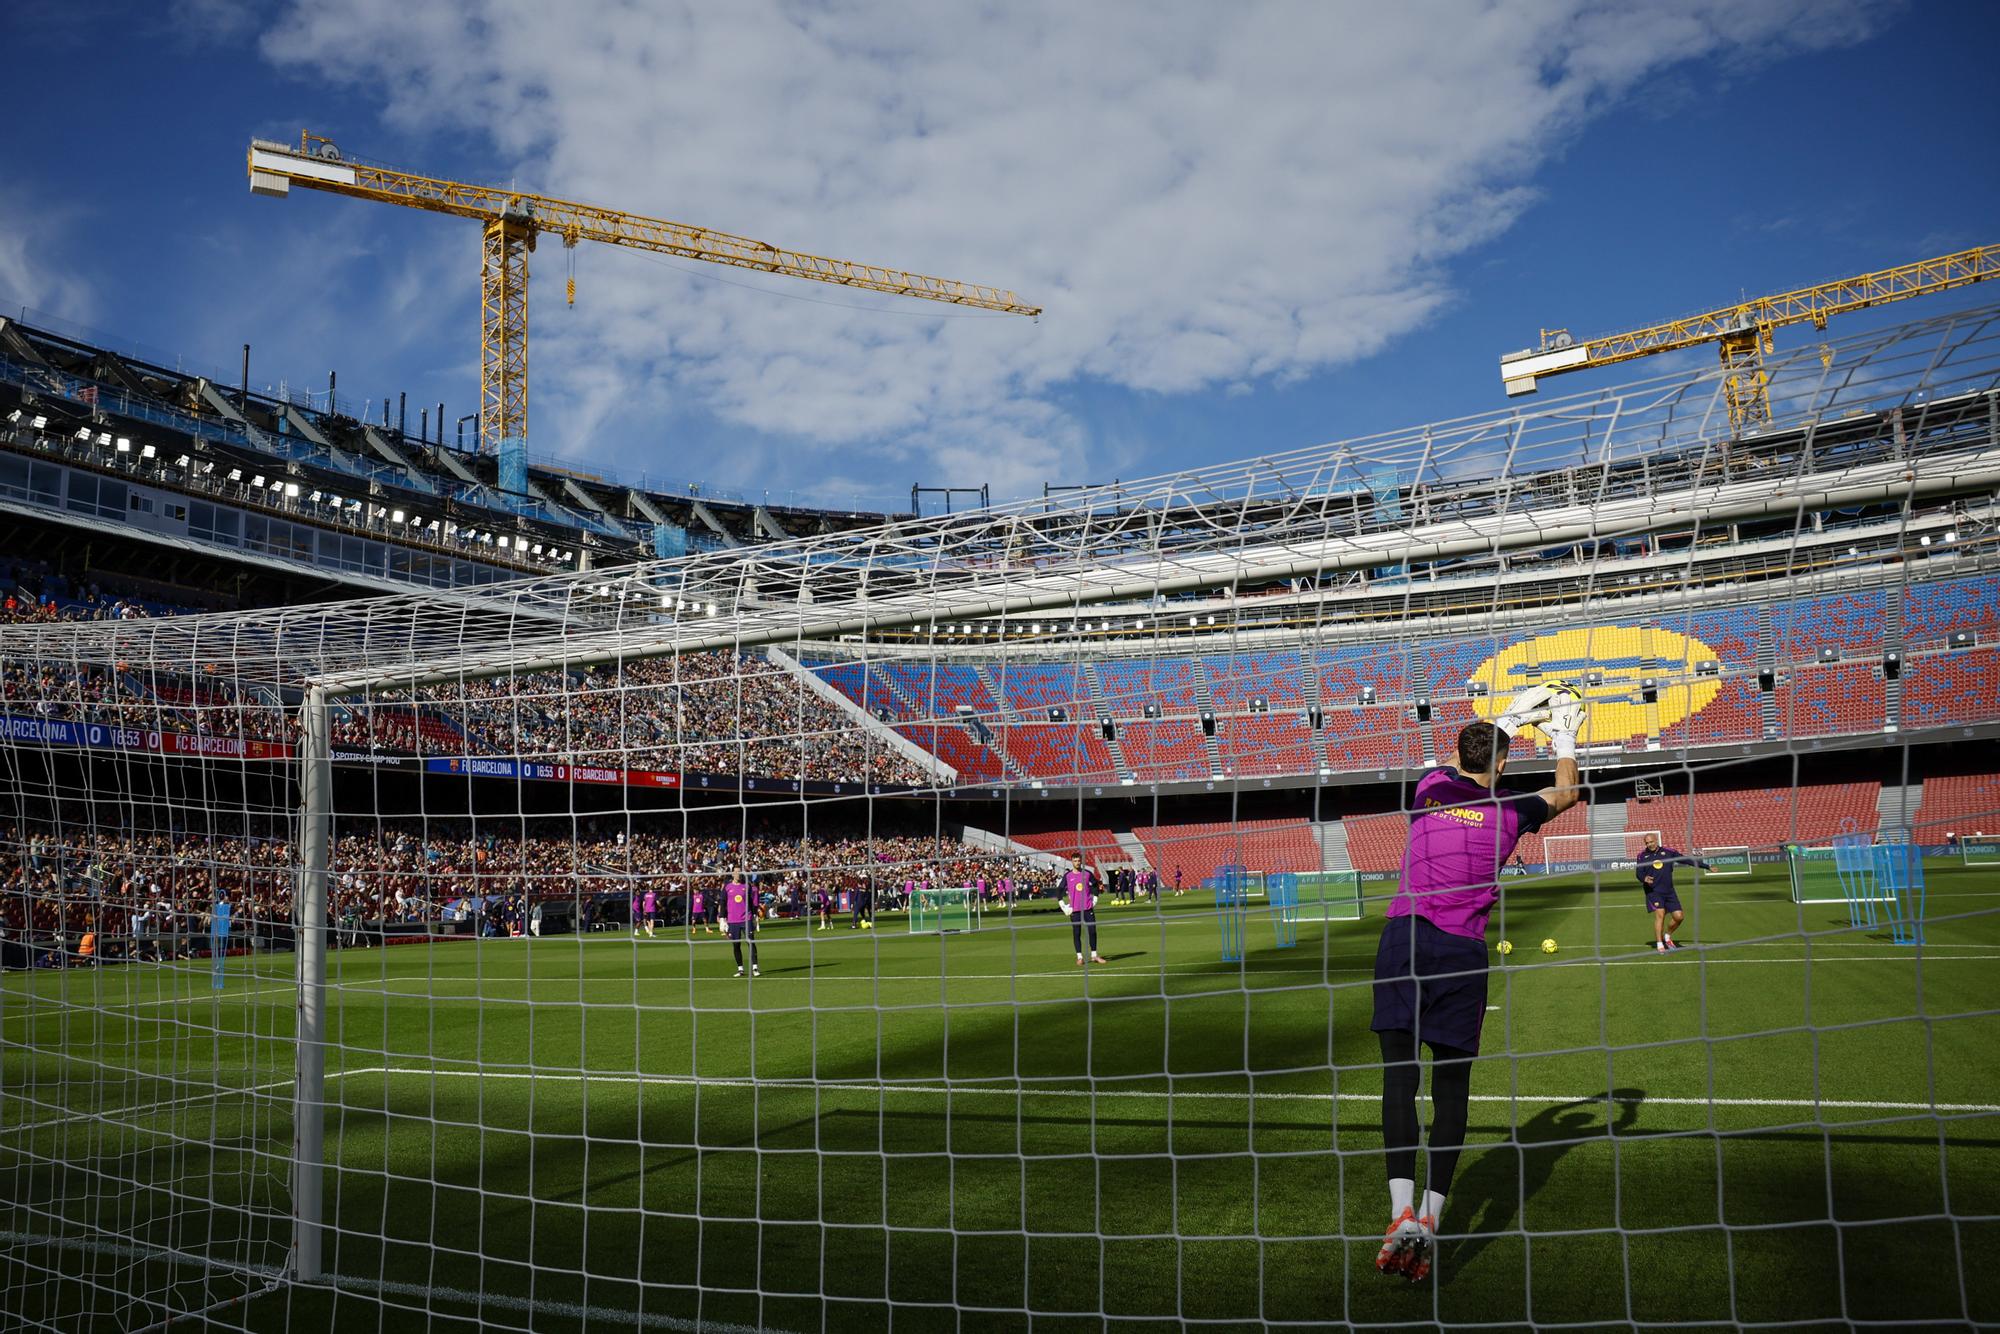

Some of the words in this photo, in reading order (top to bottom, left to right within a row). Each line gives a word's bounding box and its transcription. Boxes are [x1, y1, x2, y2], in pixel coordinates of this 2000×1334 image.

[90, 726, 101, 744] 0
[112, 729, 140, 746] 16:53
[149, 732, 159, 748] 0
[175, 735, 188, 750] FC
[191, 736, 247, 755] BARCELONA
[336, 752, 365, 762] SPOTIFY
[365, 753, 385, 764] CAMP
[386, 756, 400, 765] NOU
[461, 760, 470, 773] FC
[472, 761, 512, 775] BARCELONA
[524, 764, 531, 777] 0
[537, 765, 554, 778] 16:53
[558, 766, 565, 779] 0
[574, 767, 582, 780] FC
[582, 768, 618, 782] BARCELONA
[1444, 808, 1484, 822] CONGO
[1716, 856, 1744, 864] CONGO
